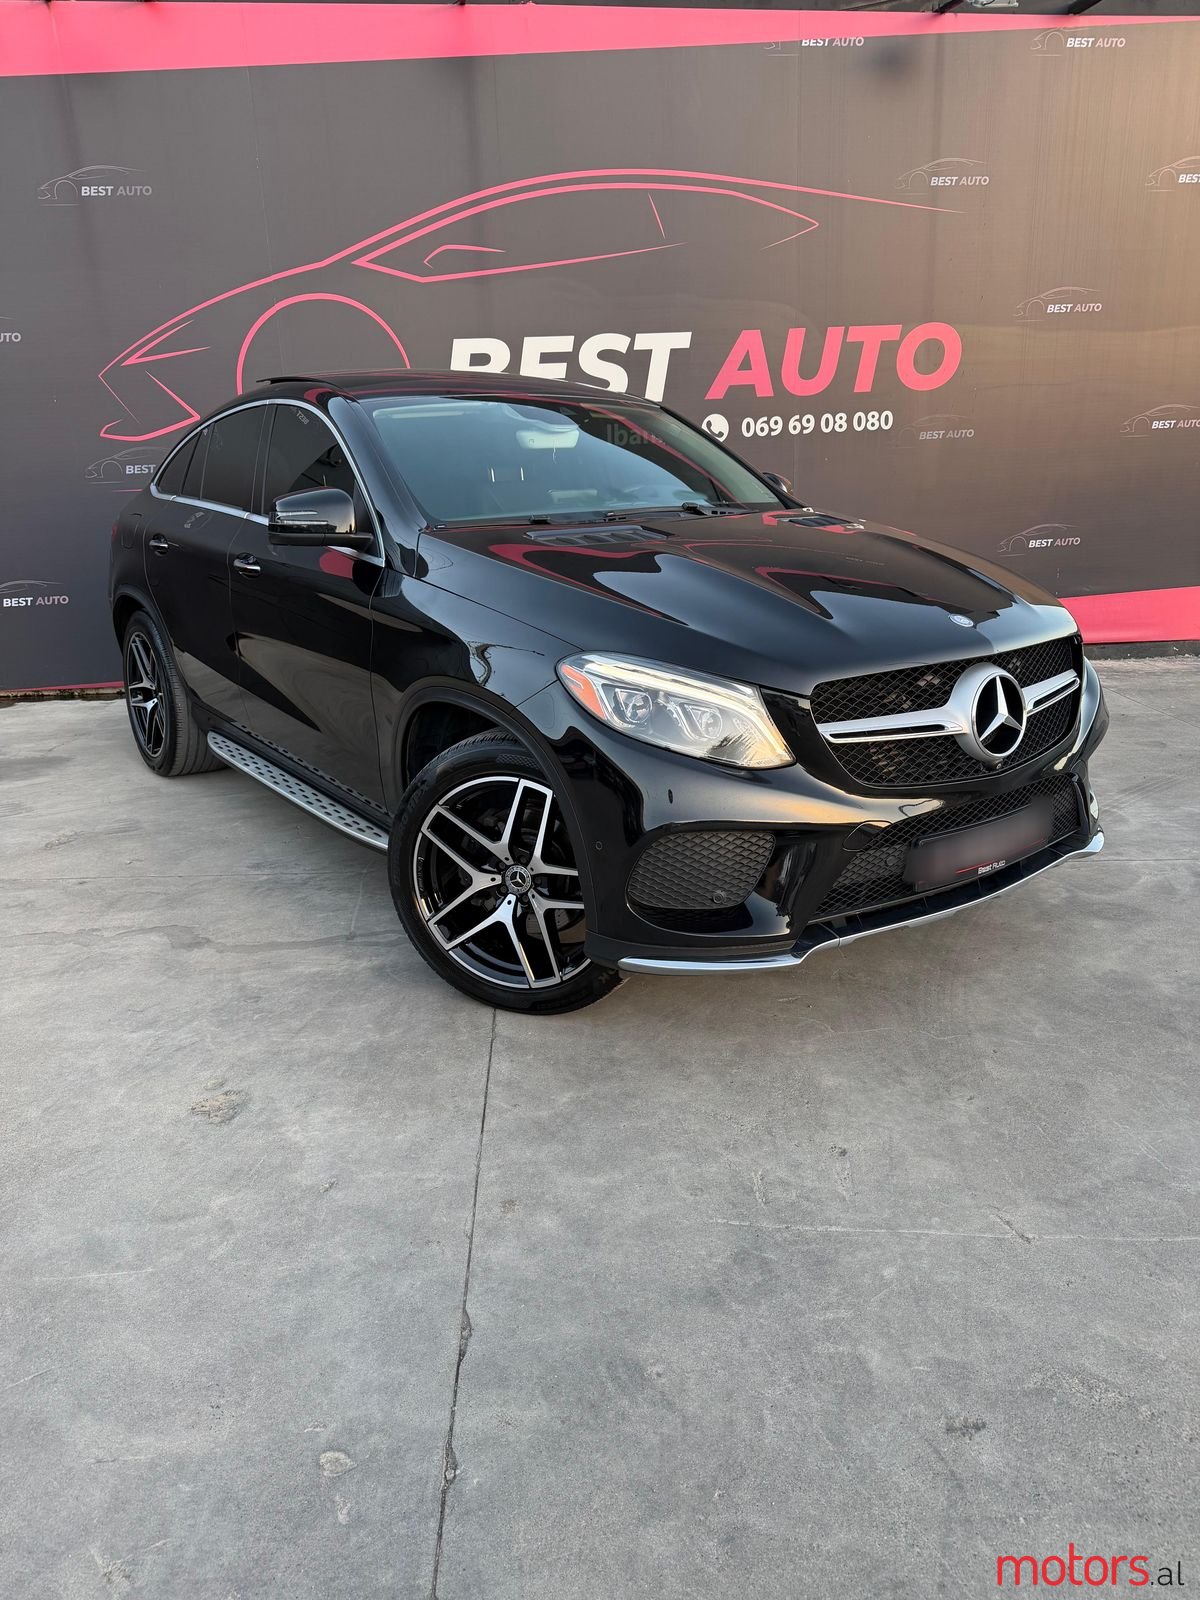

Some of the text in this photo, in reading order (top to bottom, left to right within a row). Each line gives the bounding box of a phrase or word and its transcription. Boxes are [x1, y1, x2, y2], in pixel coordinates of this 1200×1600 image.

[802, 36, 865, 47] BEST AUTO
[1066, 37, 1126, 48] BEST AUTO
[930, 176, 990, 186] BEST AUTO
[1178, 173, 1200, 183] BES
[81, 185, 153, 196] BEST AUTO
[1046, 302, 1102, 313] BEST AUTO
[704, 322, 963, 400] AUTO
[741, 410, 894, 438] 069 69 08 080
[1151, 420, 1177, 430] BEST
[918, 429, 975, 440] BEST AUTO
[125, 464, 157, 475] BEST
[1028, 537, 1081, 548] BEST AUTO
[3, 595, 70, 608] BEST AUTO
